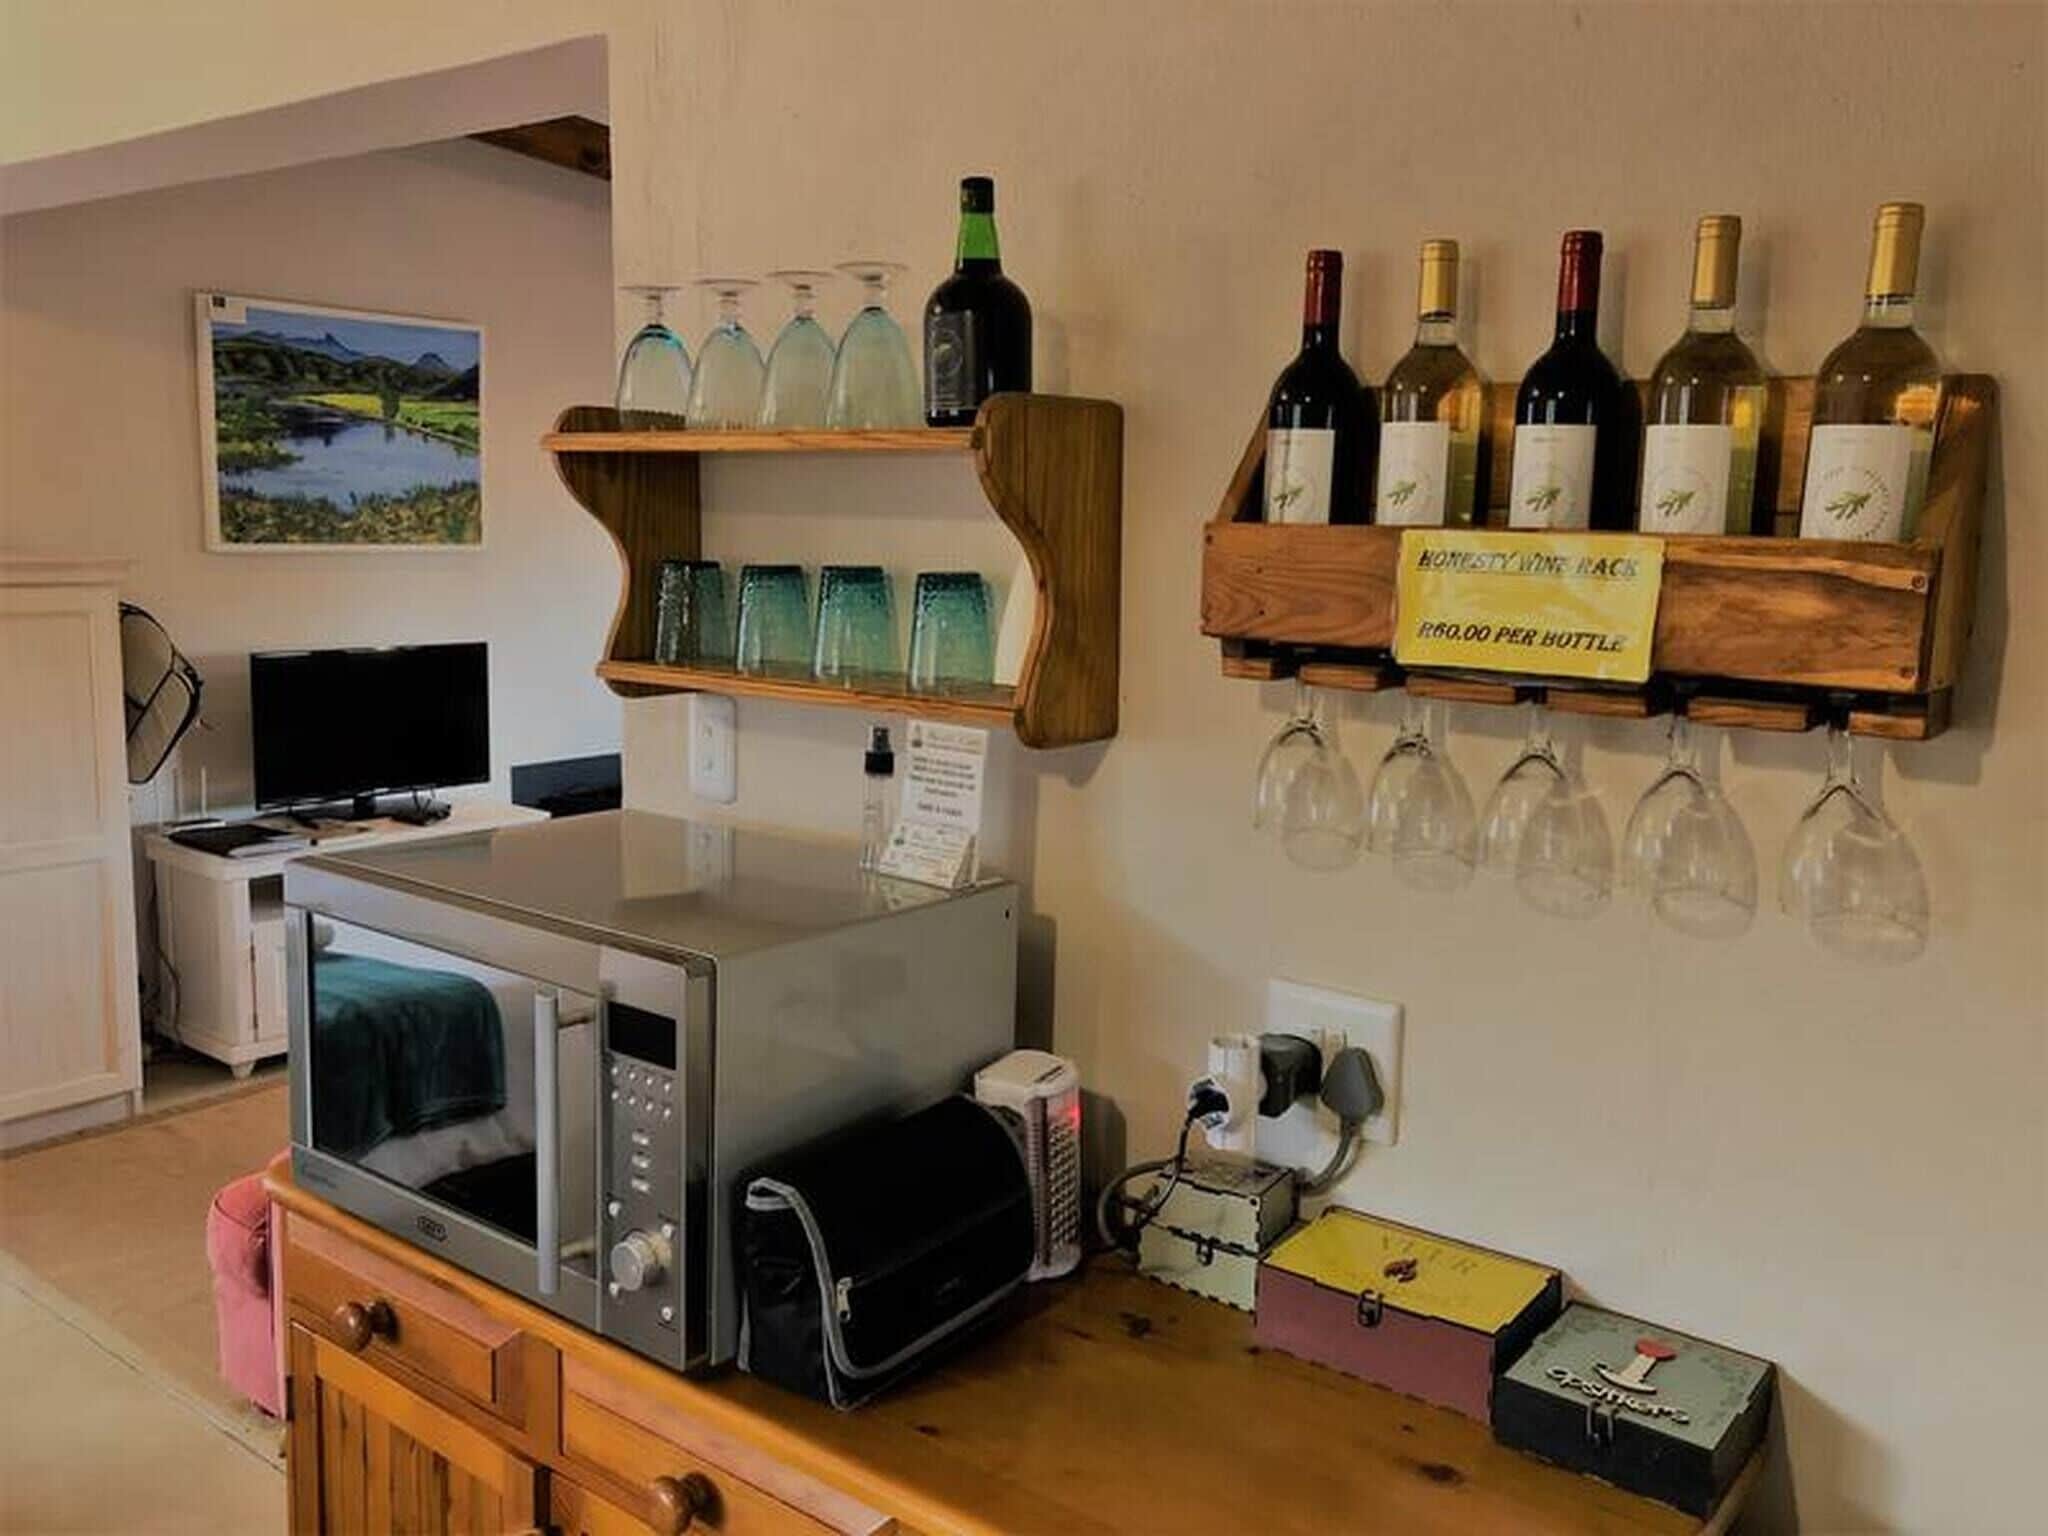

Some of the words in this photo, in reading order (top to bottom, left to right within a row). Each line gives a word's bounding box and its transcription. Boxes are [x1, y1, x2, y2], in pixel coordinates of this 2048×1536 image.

[1417, 549, 1518, 571] HONESTY
[1518, 553, 1567, 575] WINE
[1576, 557, 1638, 578] RACK
[1417, 621, 1491, 642] R60.00
[1494, 626, 1537, 647] PER
[1540, 629, 1628, 653] BOTTLE
